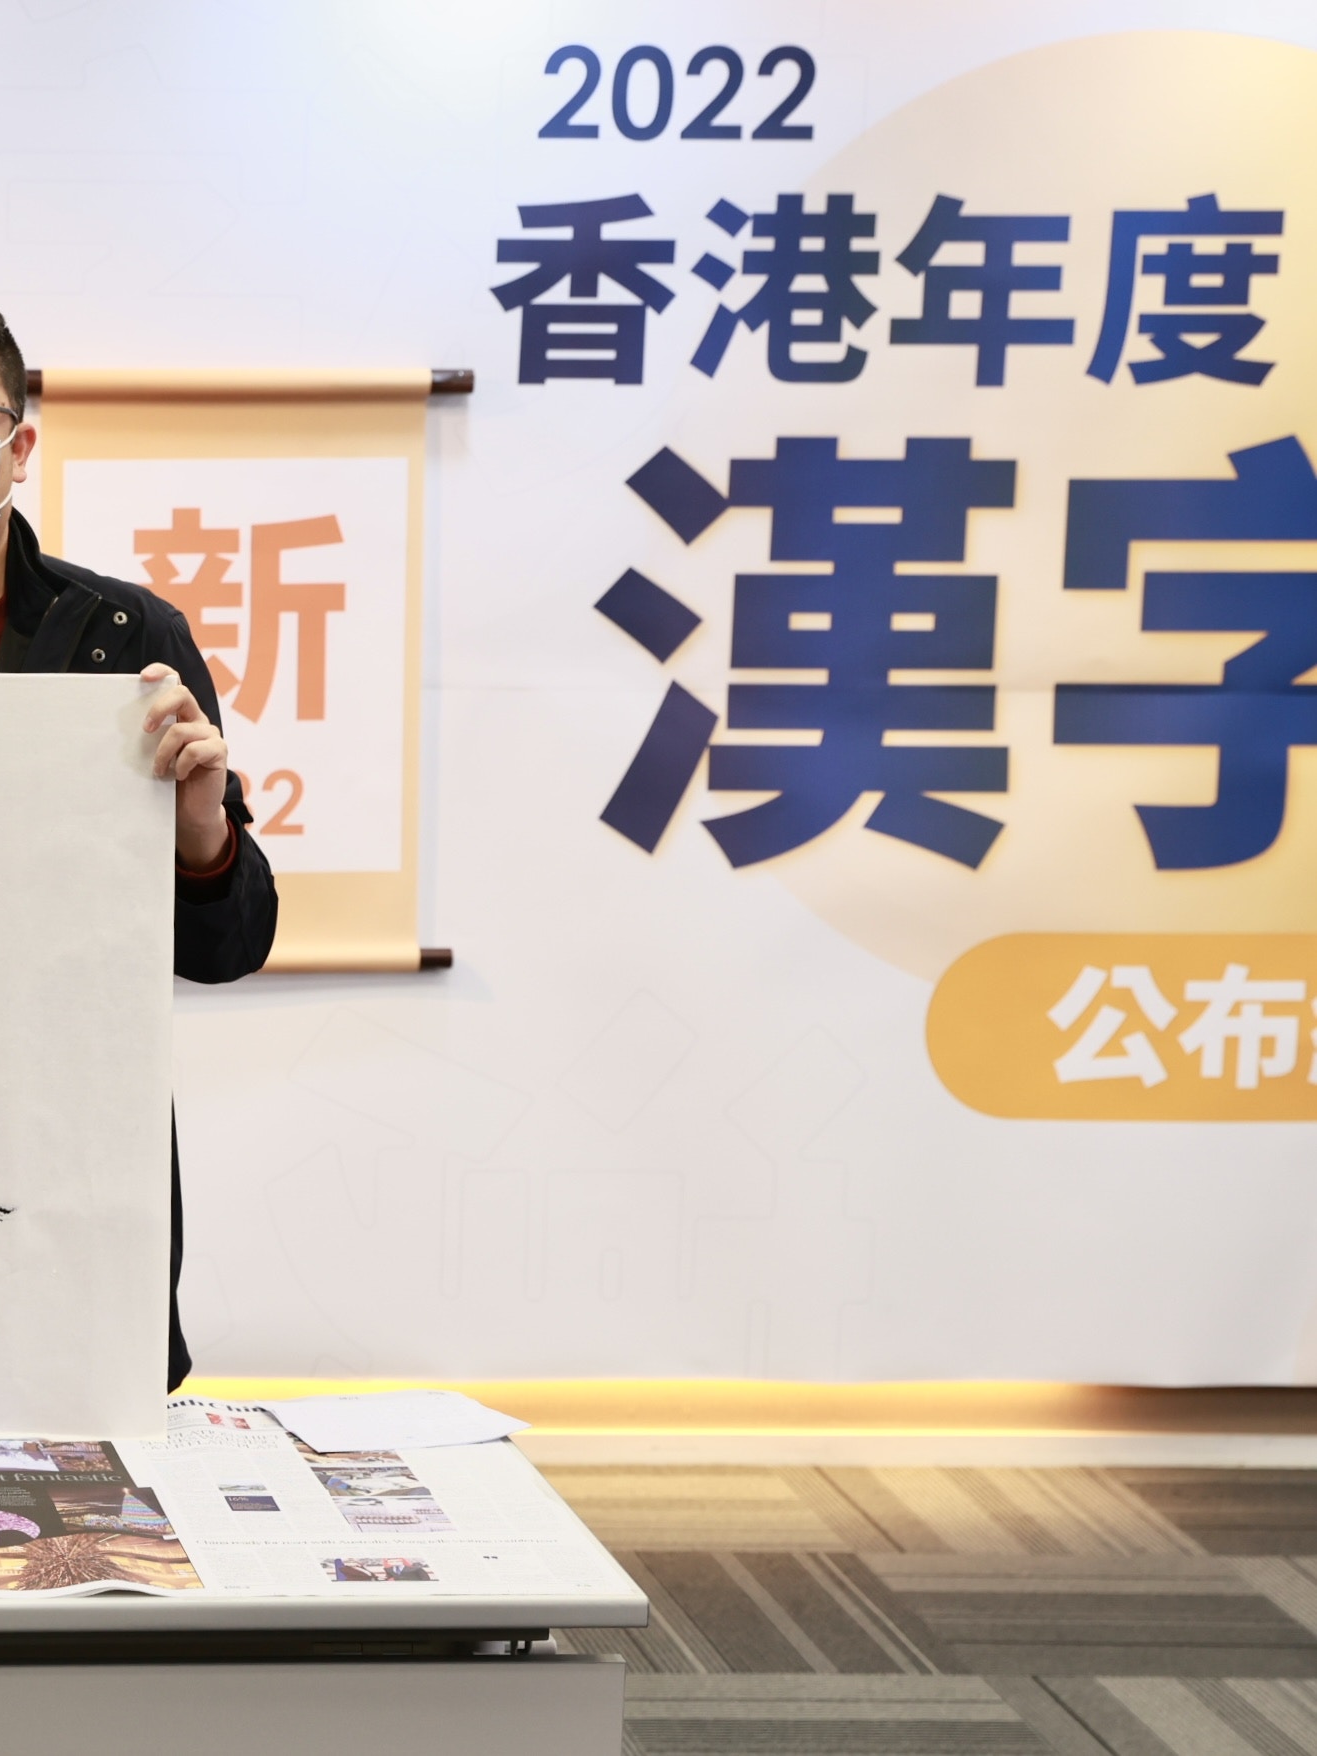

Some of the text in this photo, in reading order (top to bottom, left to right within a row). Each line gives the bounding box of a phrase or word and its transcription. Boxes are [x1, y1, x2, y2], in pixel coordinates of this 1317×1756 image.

[538, 45, 816, 142] 2022
[490, 192, 1286, 388] 香港年度
[132, 507, 347, 724] 新
[592, 434, 1317, 872] 漢字
[235, 768, 305, 836] 2
[1045, 963, 1317, 1091] 公布
[13, 1472, 123, 1483] fantastic
